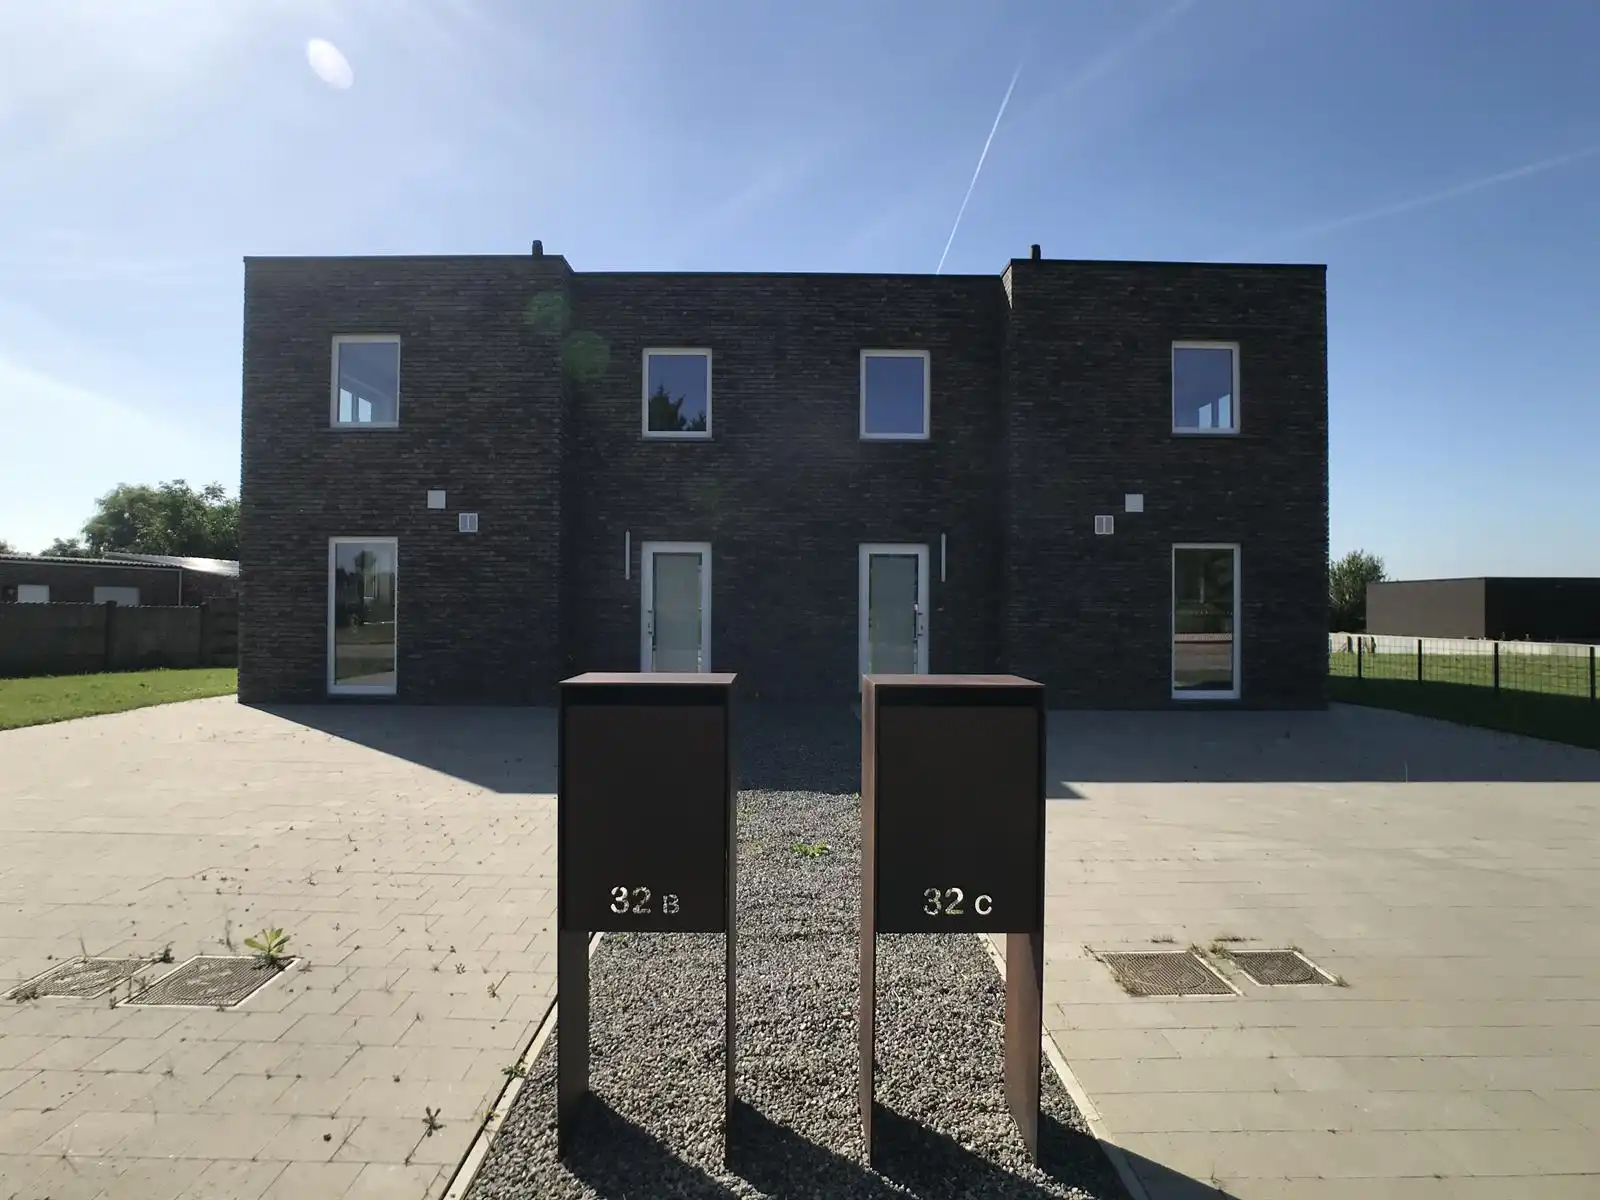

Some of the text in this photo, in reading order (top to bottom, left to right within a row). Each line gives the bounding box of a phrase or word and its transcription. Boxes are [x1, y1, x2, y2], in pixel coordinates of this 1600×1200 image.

[610, 886, 680, 914] 32 B
[923, 887, 993, 915] 32 C
